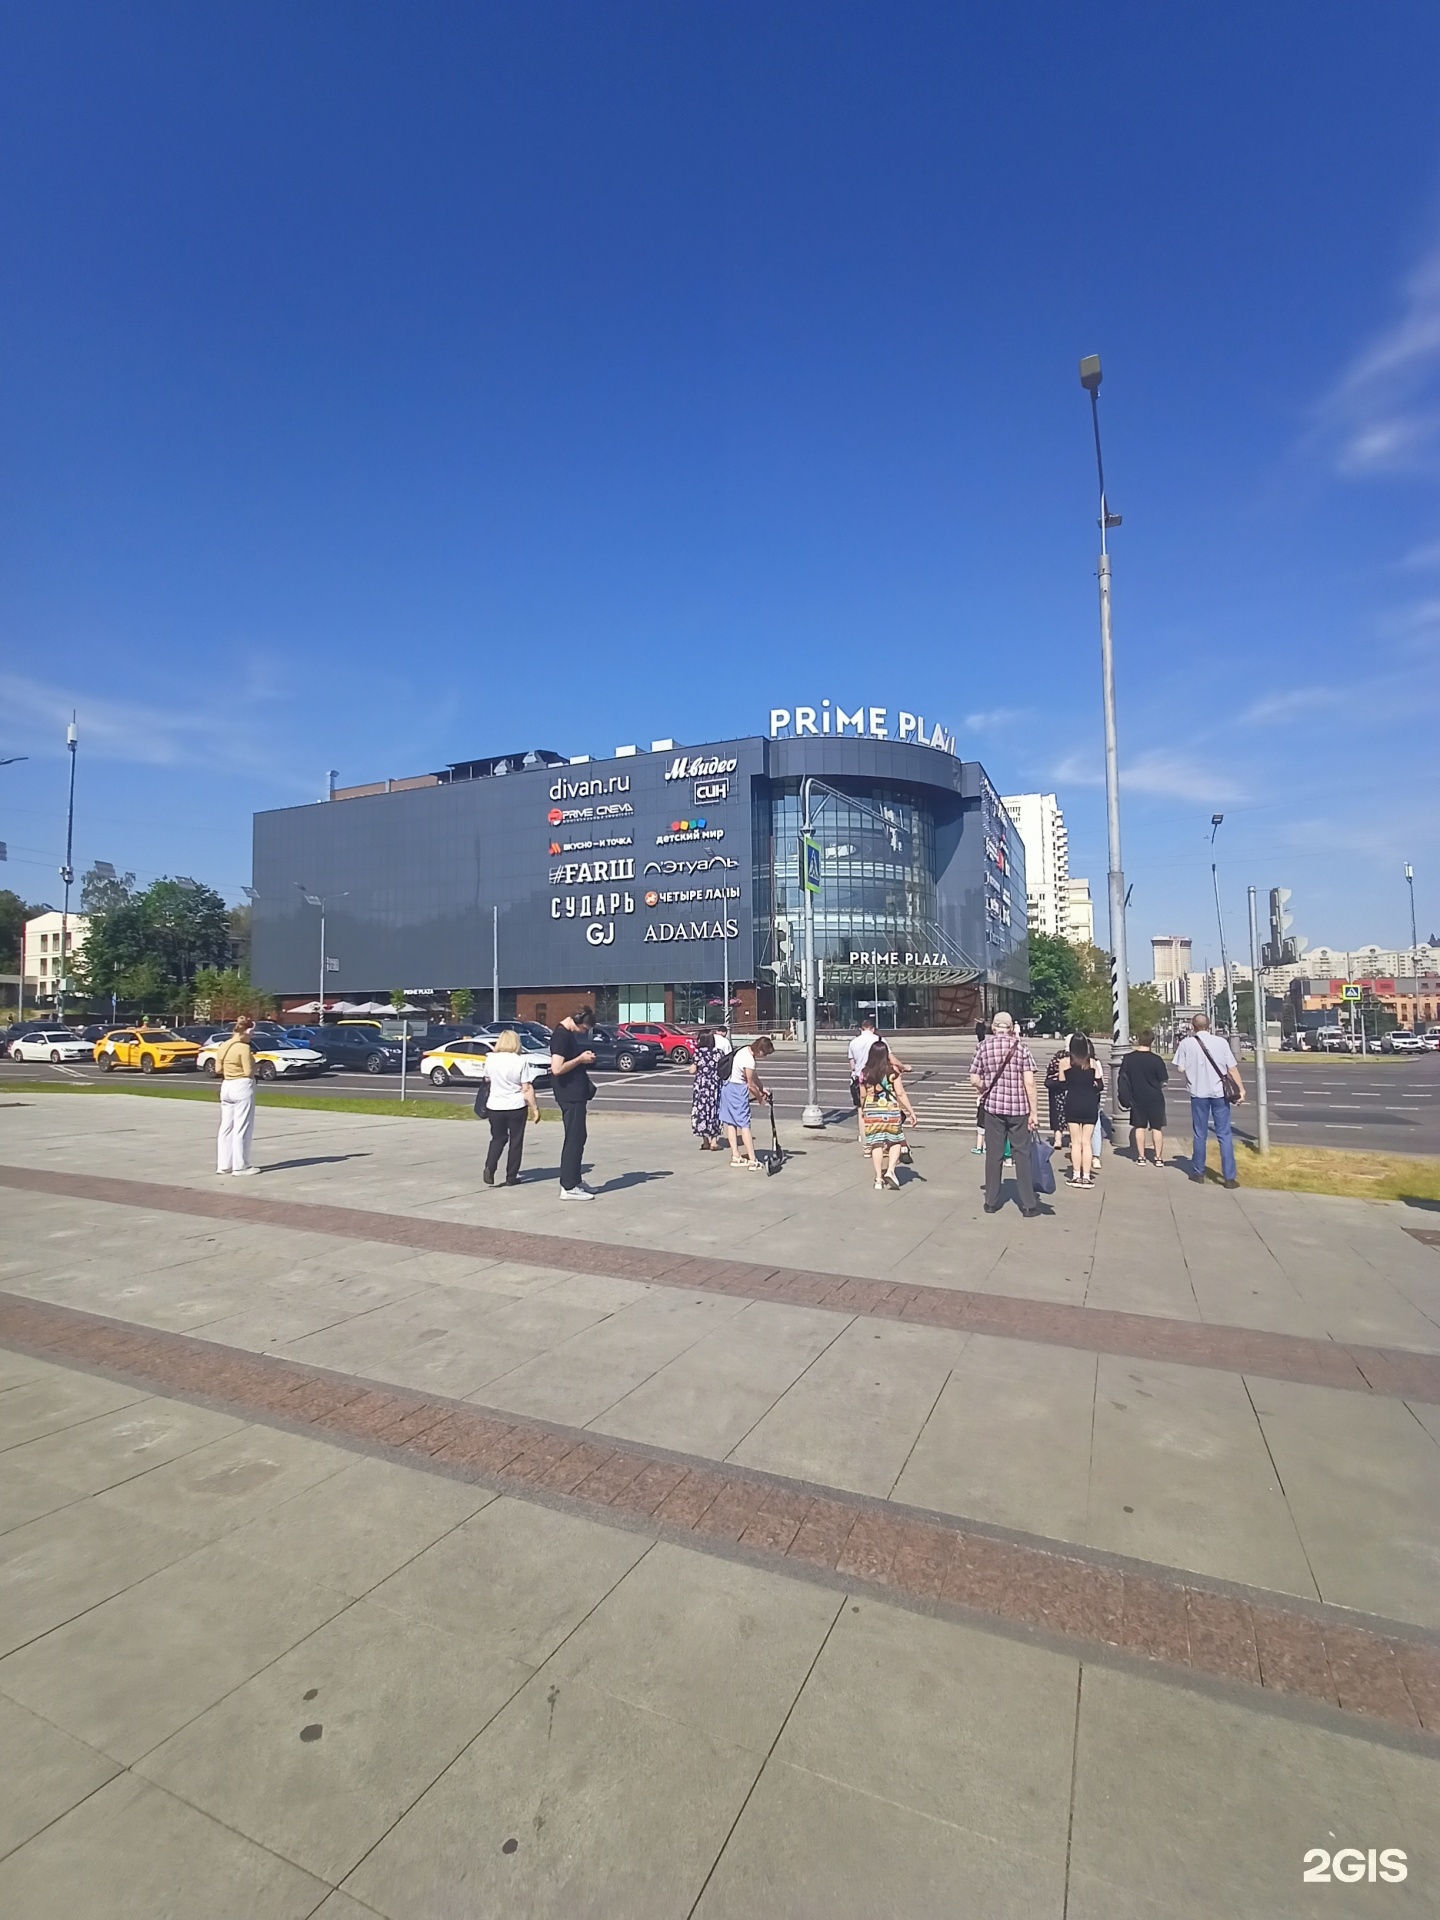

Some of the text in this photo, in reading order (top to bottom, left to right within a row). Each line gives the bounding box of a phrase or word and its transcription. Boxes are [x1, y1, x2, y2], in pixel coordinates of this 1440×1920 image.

[898, 711, 957, 757] PLA
[549, 775, 630, 800] divan.ru
[562, 807, 594, 820] PRIME
[551, 891, 634, 919] СУДАРЬ
[659, 889, 703, 903] ЧЕТЫРЕ
[586, 922, 615, 945] GJ
[643, 918, 739, 942] ADAMAS
[905, 952, 949, 966] PLAZA
